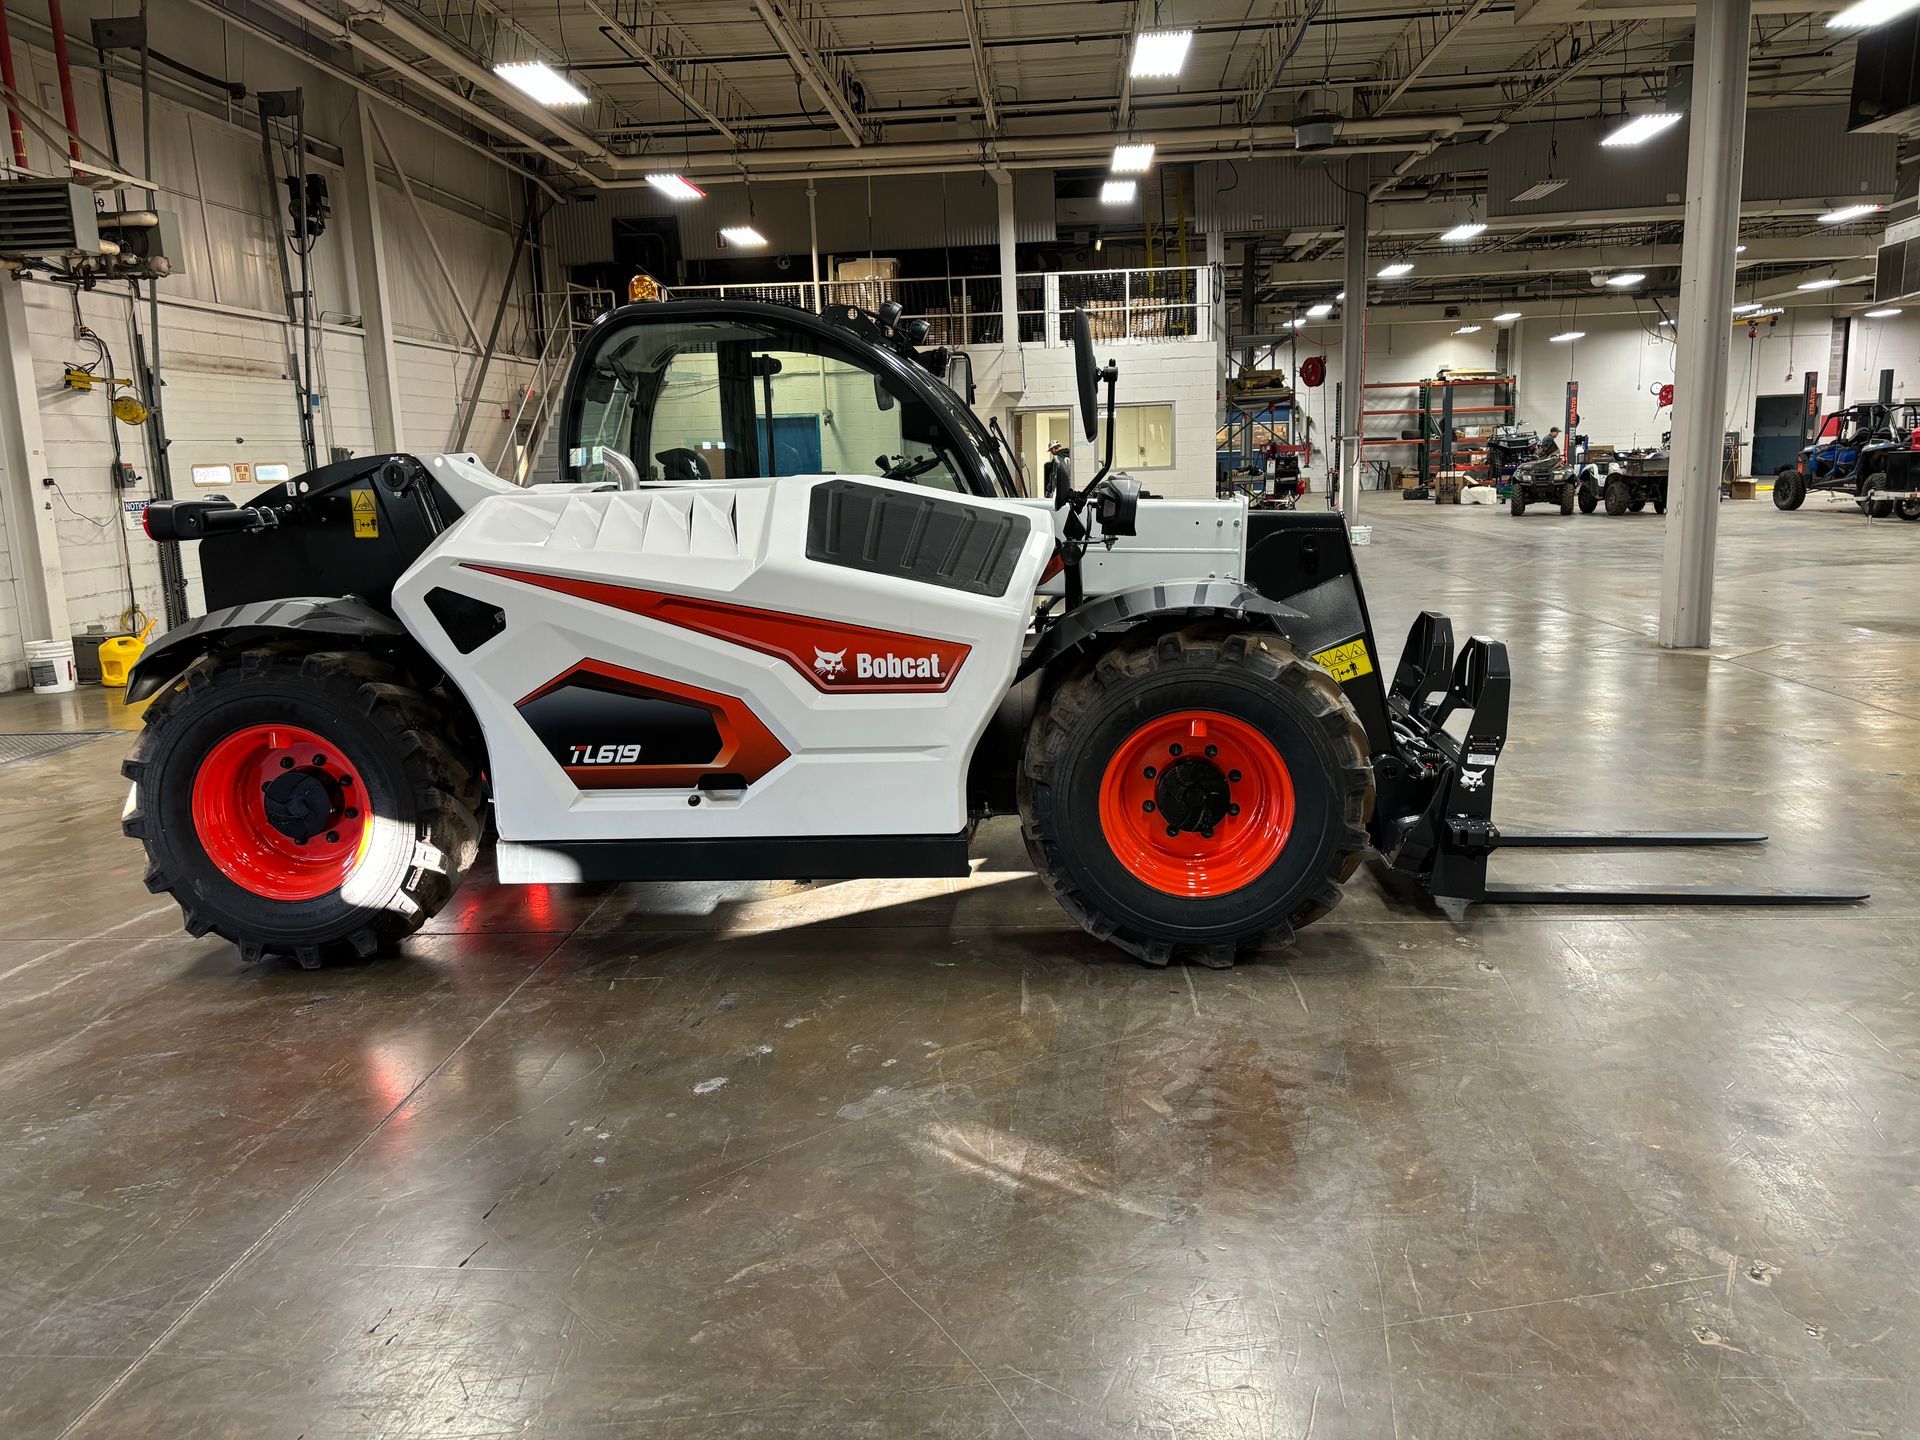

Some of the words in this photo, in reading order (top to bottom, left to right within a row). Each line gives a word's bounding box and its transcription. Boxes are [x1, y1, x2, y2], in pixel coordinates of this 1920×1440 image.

[125, 502, 149, 511] NOTICE
[856, 652, 941, 679] Bobcat
[569, 744, 642, 764] TL619
